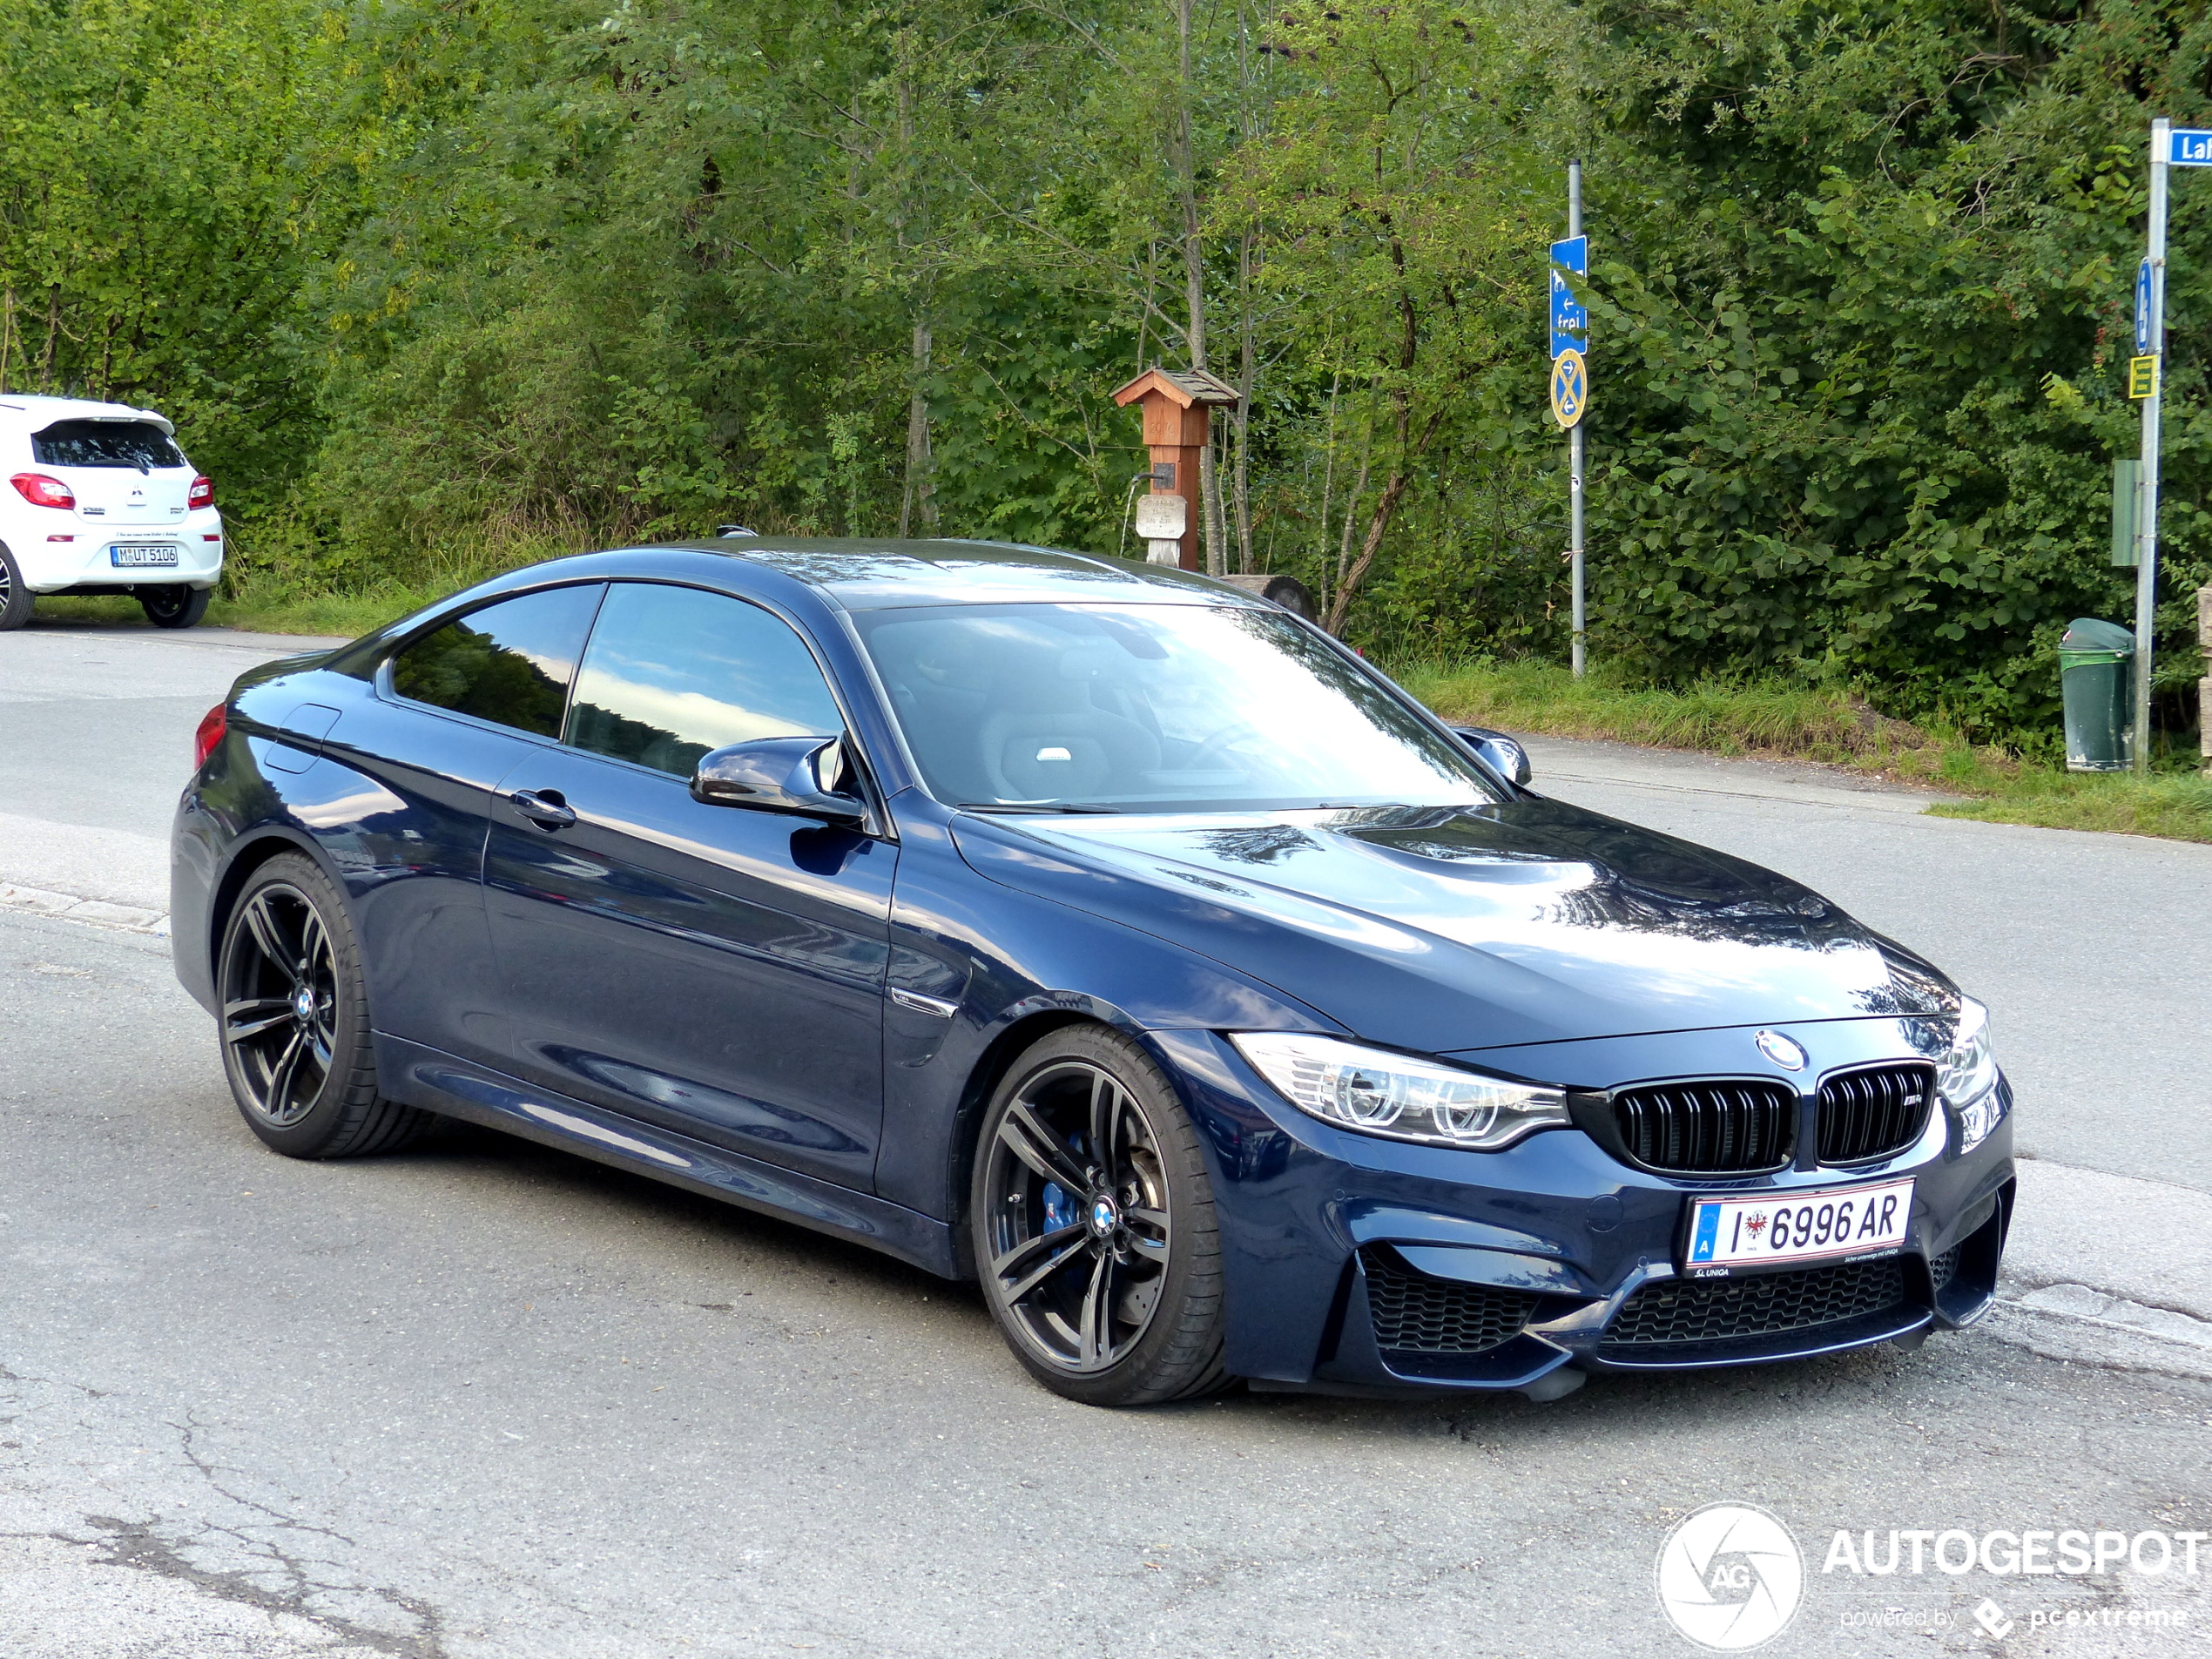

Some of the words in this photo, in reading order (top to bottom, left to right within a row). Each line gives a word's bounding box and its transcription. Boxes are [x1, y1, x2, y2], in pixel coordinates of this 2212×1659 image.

[119, 549, 128, 562] M
[133, 549, 147, 562] UT
[149, 549, 176, 562] 5106
[1730, 1211, 1743, 1253] I
[1770, 1201, 1854, 1250] 6996
[1857, 1194, 1898, 1240] AR
[1698, 1240, 1709, 1253] A
[1705, 1268, 1730, 1277] UNIQA
